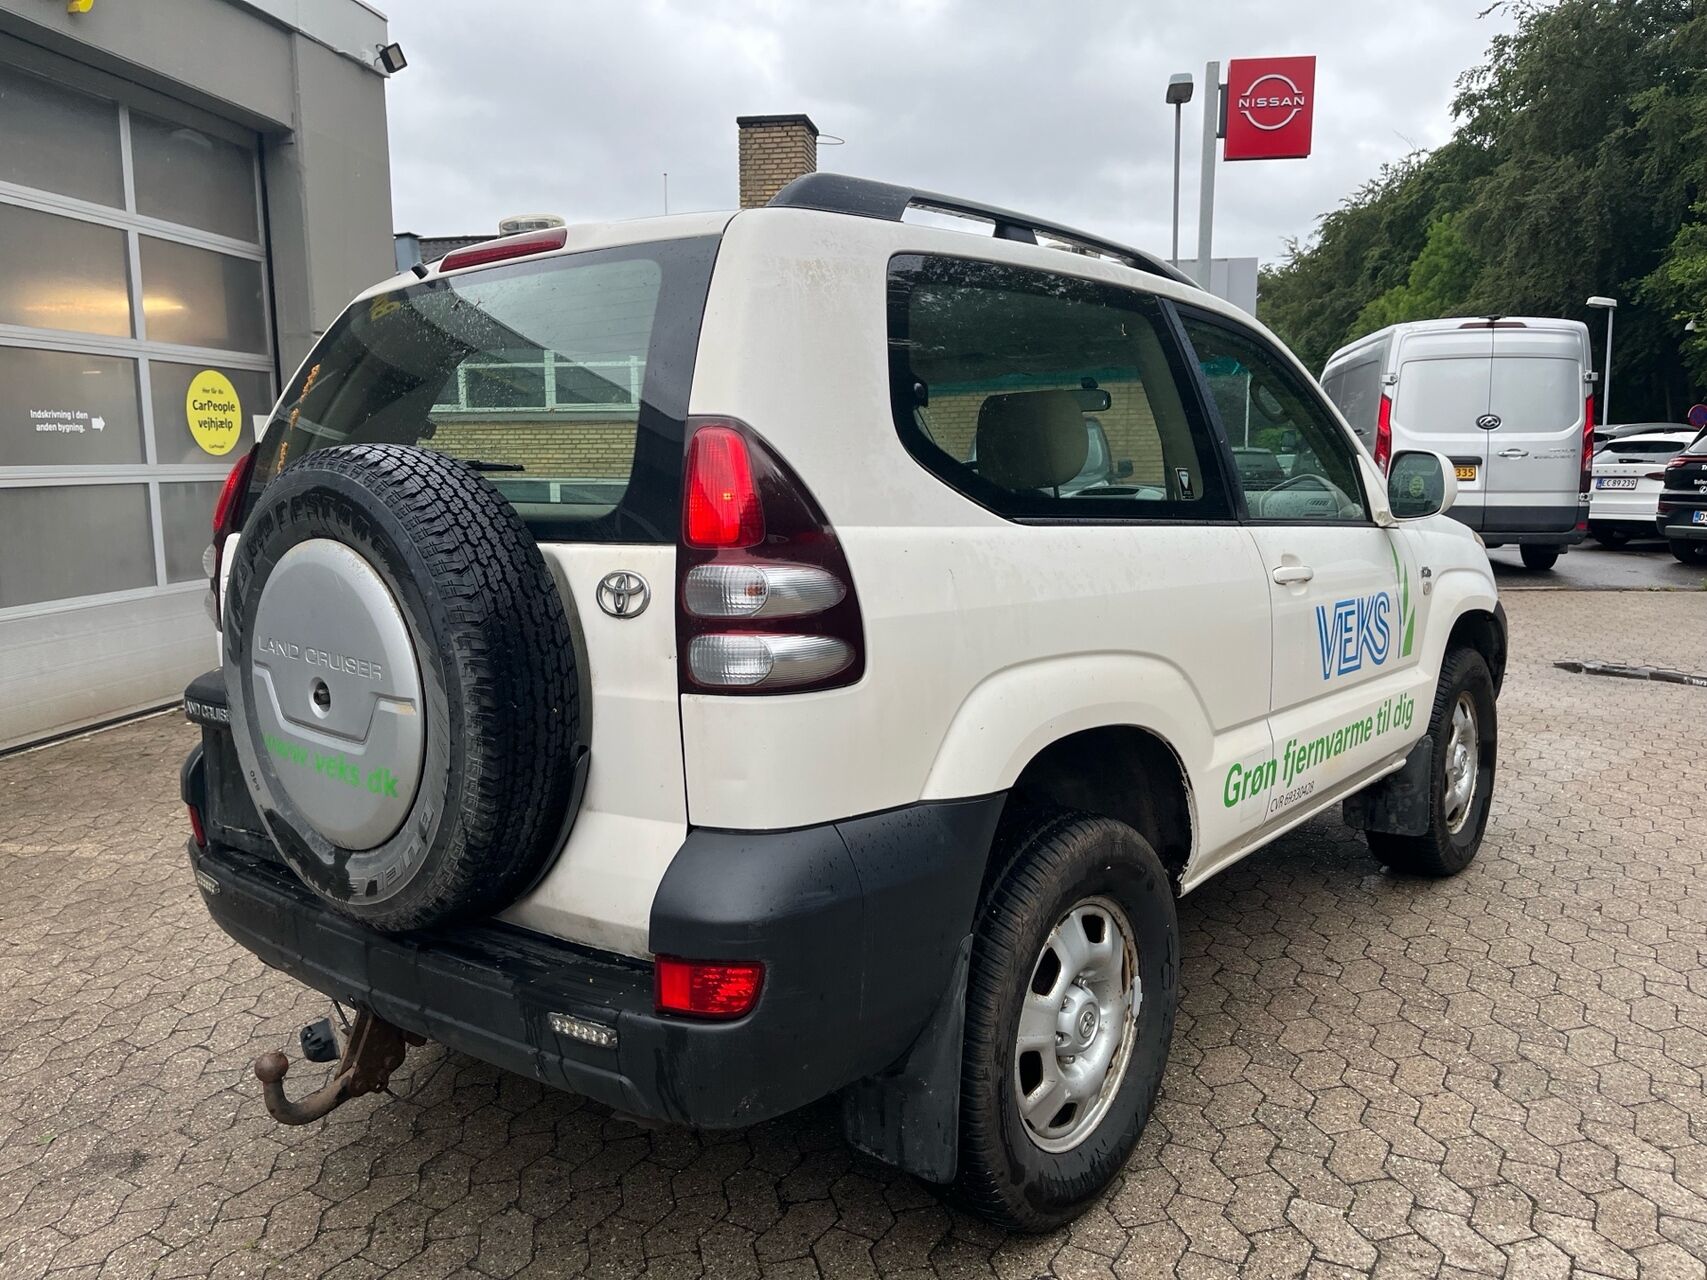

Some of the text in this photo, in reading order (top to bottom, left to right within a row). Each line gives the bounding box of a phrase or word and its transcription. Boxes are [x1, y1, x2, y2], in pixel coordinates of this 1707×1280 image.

[1238, 96, 1305, 108] NISSAN
[192, 399, 236, 414] CarPeople
[30, 409, 71, 420] Indskrivning
[76, 410, 88, 419] den
[36, 422, 57, 431] anden
[198, 417, 233, 432] vejhjælp
[1456, 468, 1474, 477] 335
[1316, 591, 1390, 680] VEKS
[258, 635, 382, 680] LAND CRUISER
[1223, 692, 1415, 808] Grøn fjernvarme til dig
[263, 731, 399, 798] www.veks.dk
[1269, 794, 1285, 812] CVR
